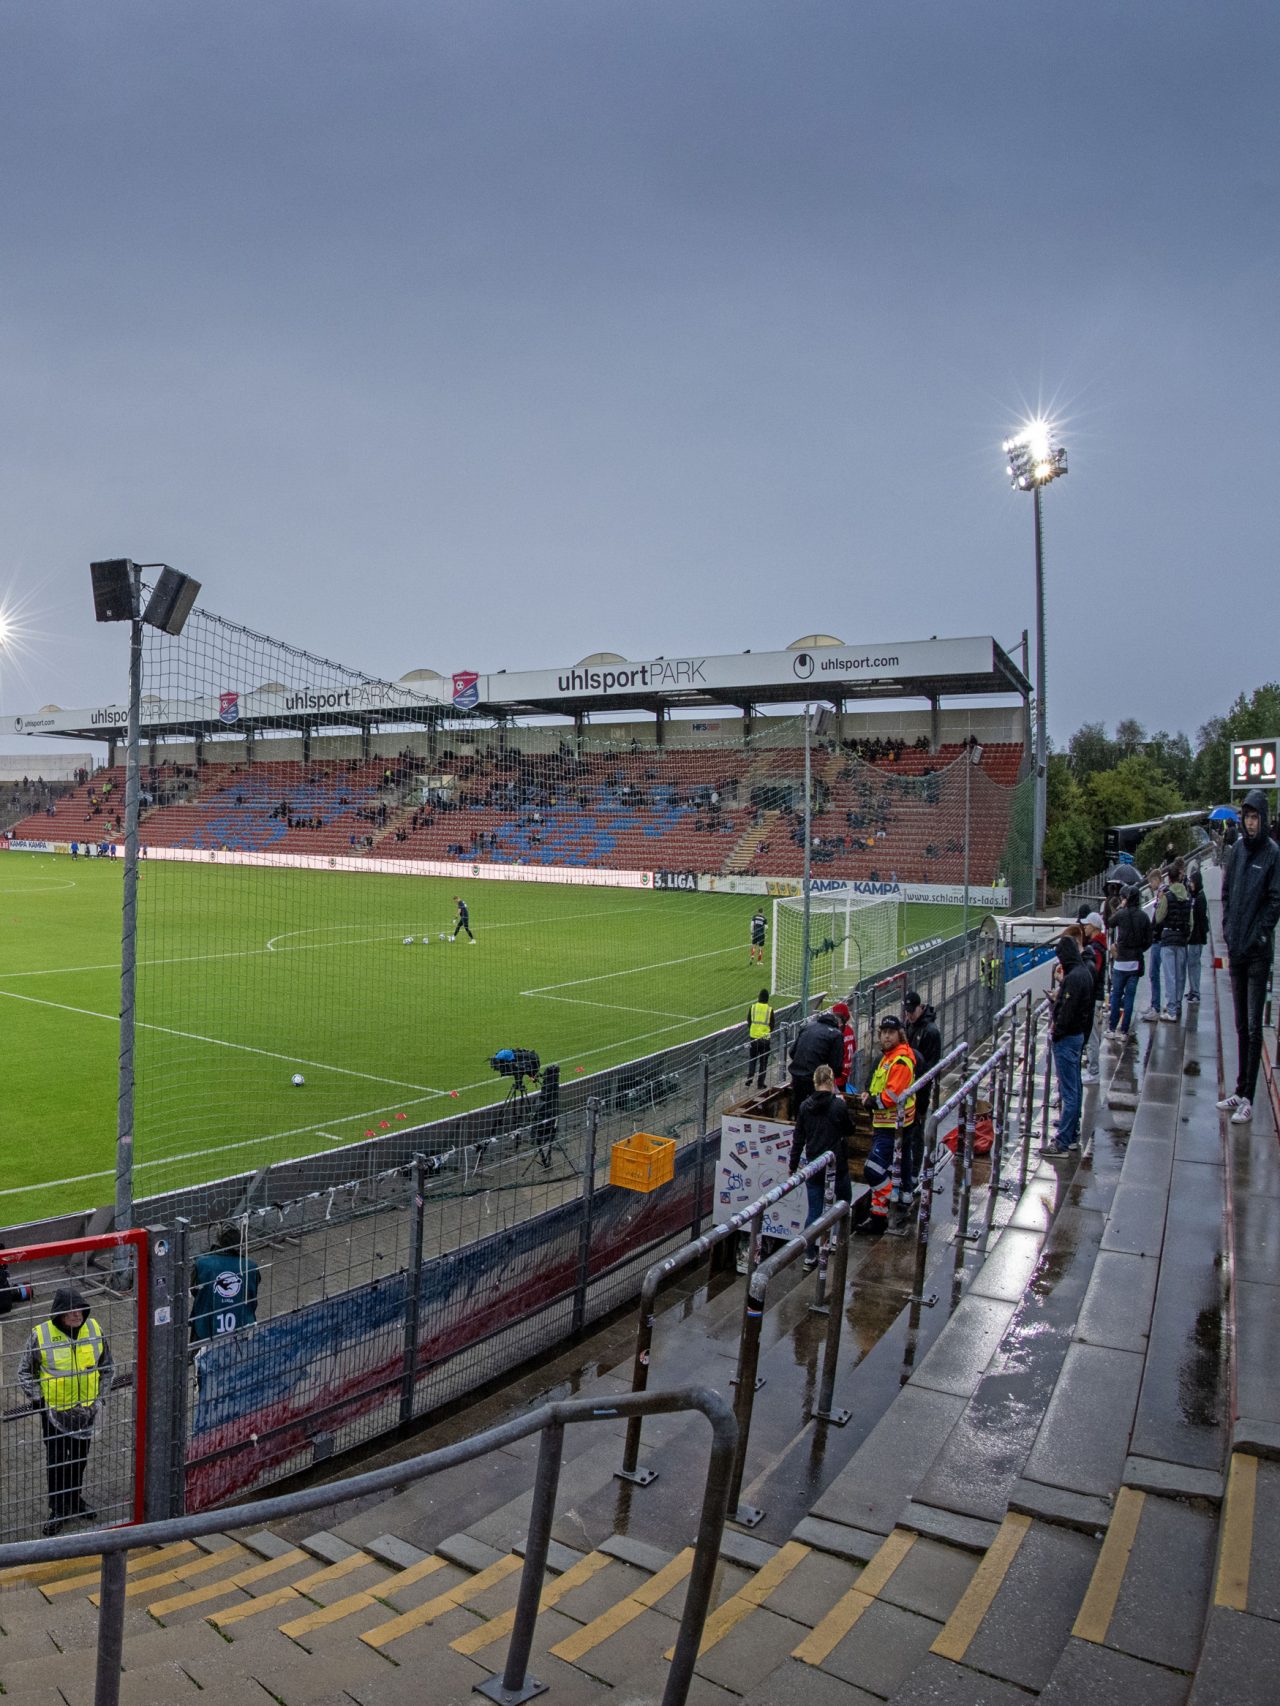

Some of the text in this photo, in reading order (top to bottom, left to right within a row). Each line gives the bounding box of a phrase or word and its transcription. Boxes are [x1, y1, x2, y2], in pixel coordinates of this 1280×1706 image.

[821, 656, 899, 672] uhlsport.com
[558, 660, 707, 693] uhlsportPARK
[286, 685, 393, 710] uhlsportPARK
[24, 719, 55, 728] uhlsport.com
[10, 839, 27, 847] KAMPA
[28, 841, 47, 849] KAMPA
[654, 873, 696, 889] 3. LIGA
[854, 881, 900, 895] KAMPA
[907, 893, 1008, 906] www.schlandrs-laas.it
[216, 1312, 236, 1333] 10
